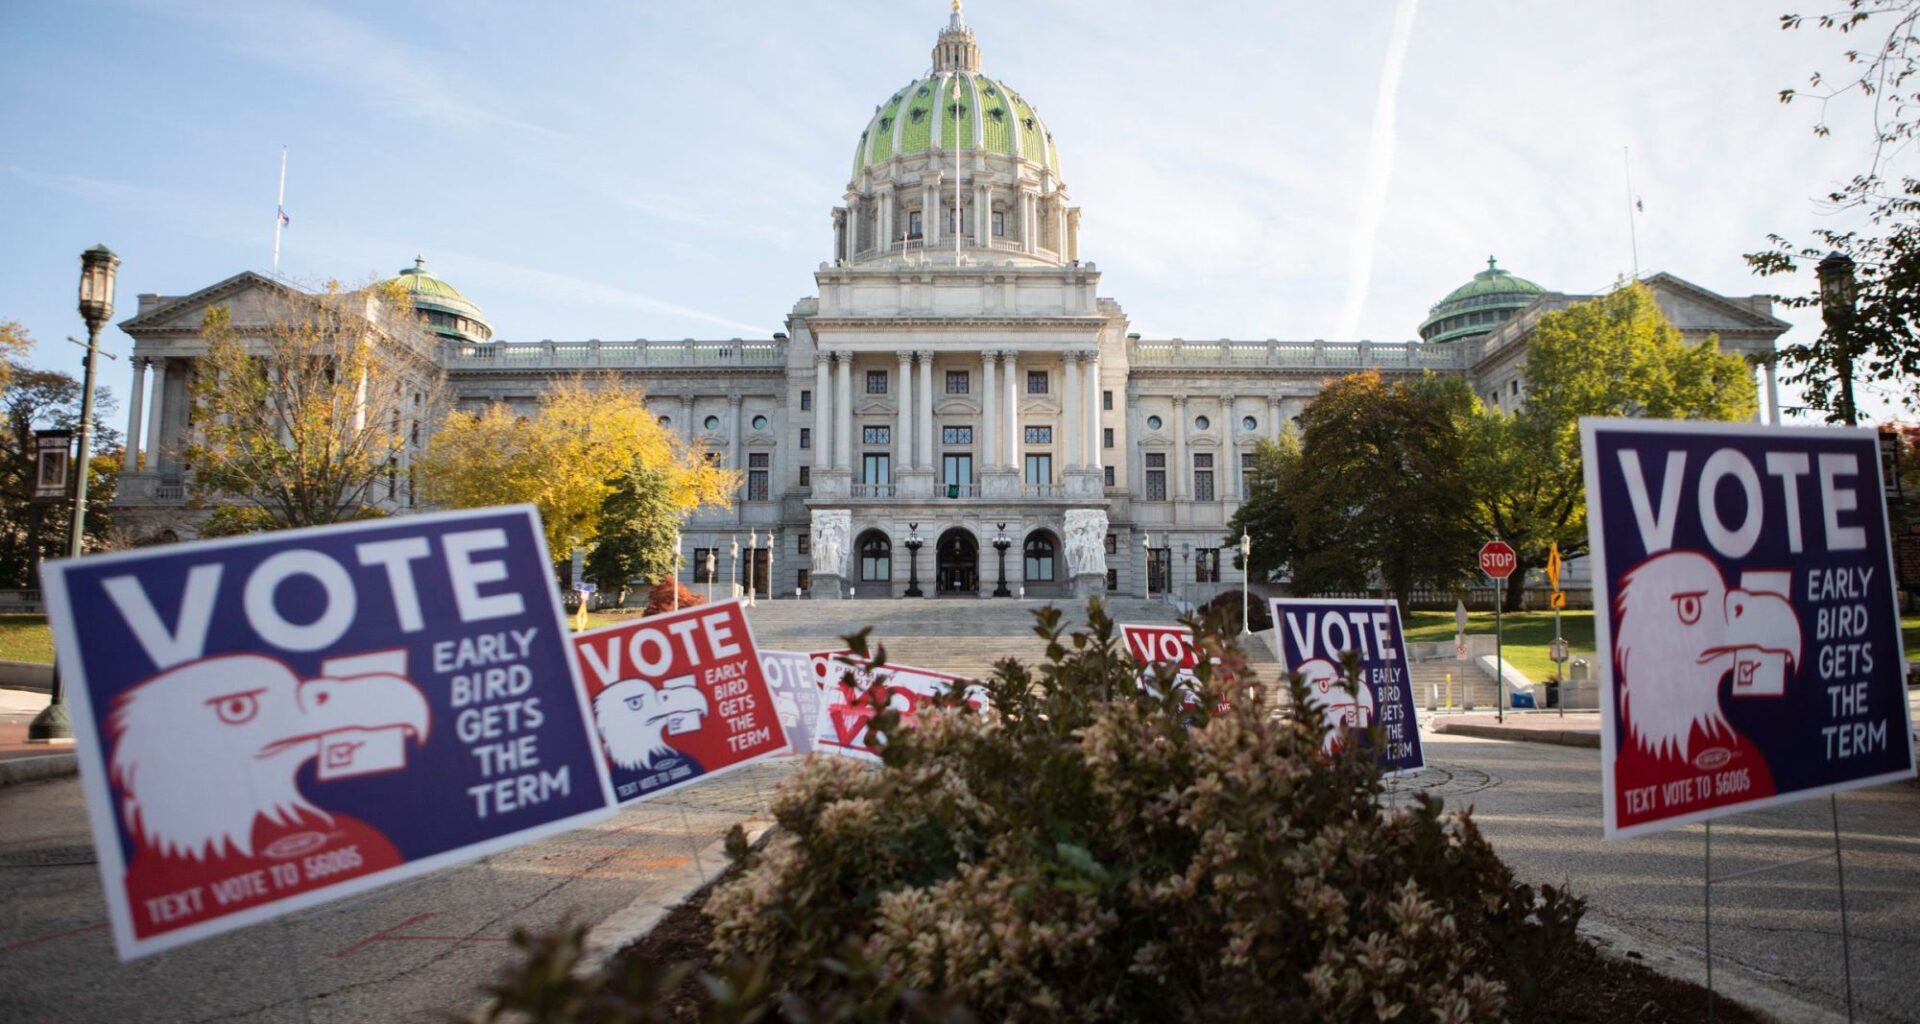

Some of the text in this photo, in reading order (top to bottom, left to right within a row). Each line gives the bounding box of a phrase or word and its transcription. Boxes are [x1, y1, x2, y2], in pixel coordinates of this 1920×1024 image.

[1617, 448, 1868, 559] VOTE
[1482, 553, 1513, 567] STOP
[102, 528, 525, 673] VOTE
[1808, 567, 1874, 601] EARLY
[1286, 611, 1397, 662] VOTE
[1816, 605, 1868, 641] BIRD
[433, 627, 538, 673] EARLY
[578, 611, 741, 685] VOTE
[1818, 643, 1873, 679] GETS
[451, 664, 533, 708] BIRD
[704, 660, 748, 686] EARLY
[714, 678, 749, 701] BIRD
[763, 656, 811, 689] OTE
[718, 694, 755, 717] GETS
[1378, 686, 1400, 702] BIRD
[1828, 683, 1869, 717] THE
[456, 698, 545, 743] GETS
[726, 713, 756, 733] THE
[1386, 724, 1403, 740] THE
[472, 736, 540, 777] THE
[726, 726, 770, 753] TERM
[1822, 720, 1886, 760] TERM
[467, 765, 571, 819] TERM
[1624, 768, 1750, 816] TEXT VOTE TO 56005
[146, 886, 204, 925] TEXT
[211, 870, 268, 905] VOTE
[270, 862, 299, 889] TO
